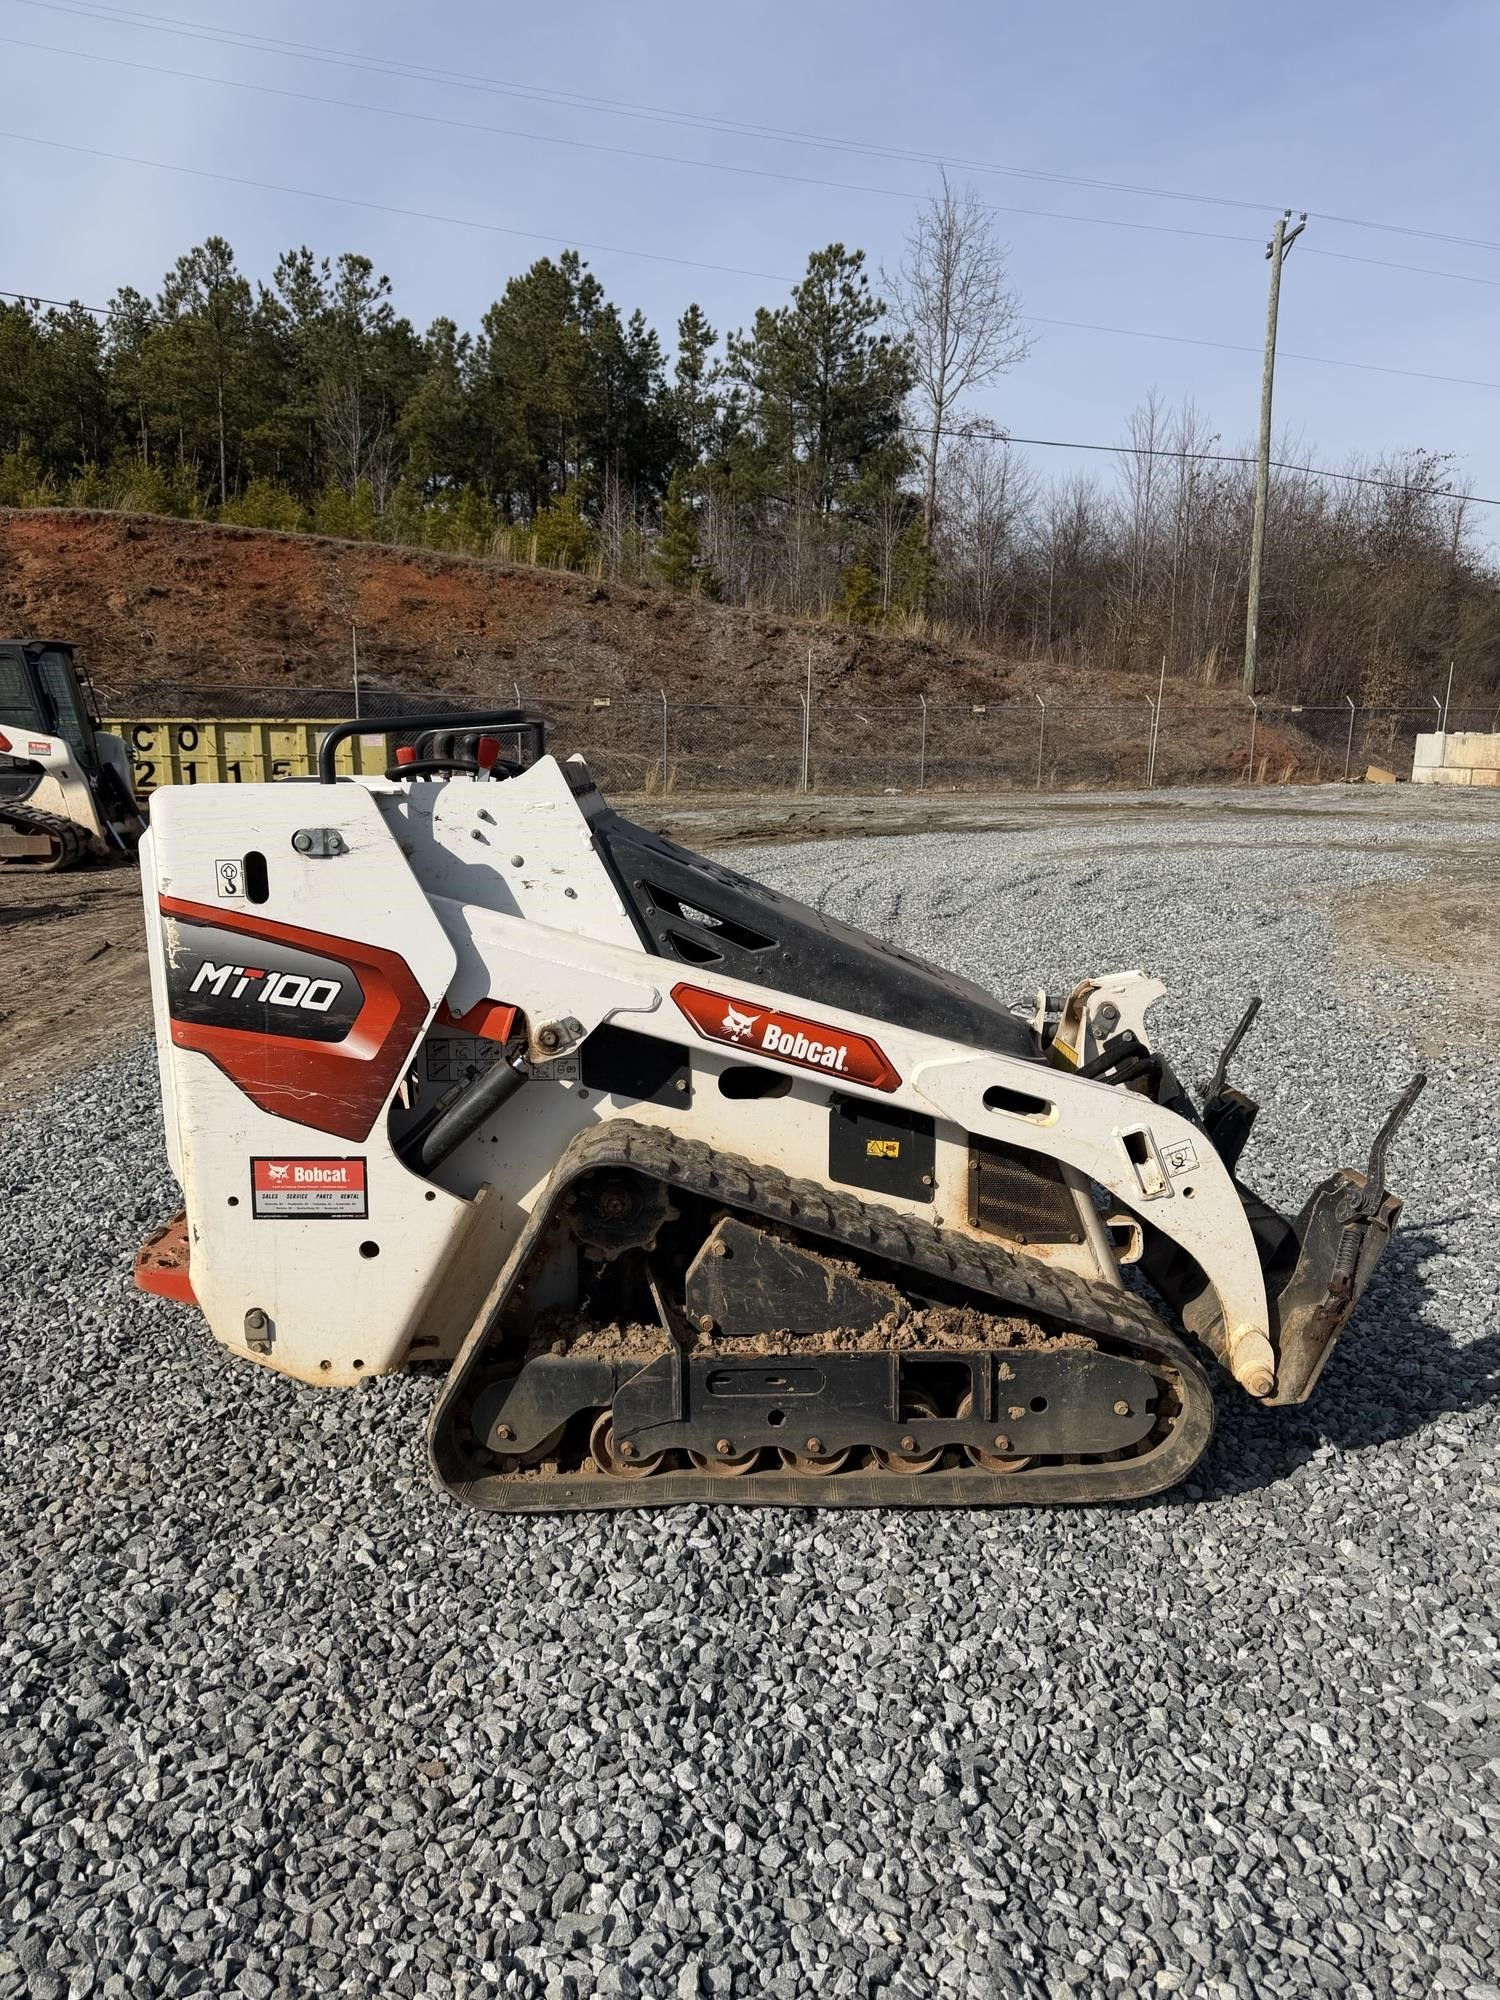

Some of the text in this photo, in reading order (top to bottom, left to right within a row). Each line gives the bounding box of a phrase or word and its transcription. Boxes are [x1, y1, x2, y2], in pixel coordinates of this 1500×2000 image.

[189, 961, 342, 1012] MT100
[761, 1023, 848, 1072] Bobcat
[294, 1166, 347, 1183] Bobcat
